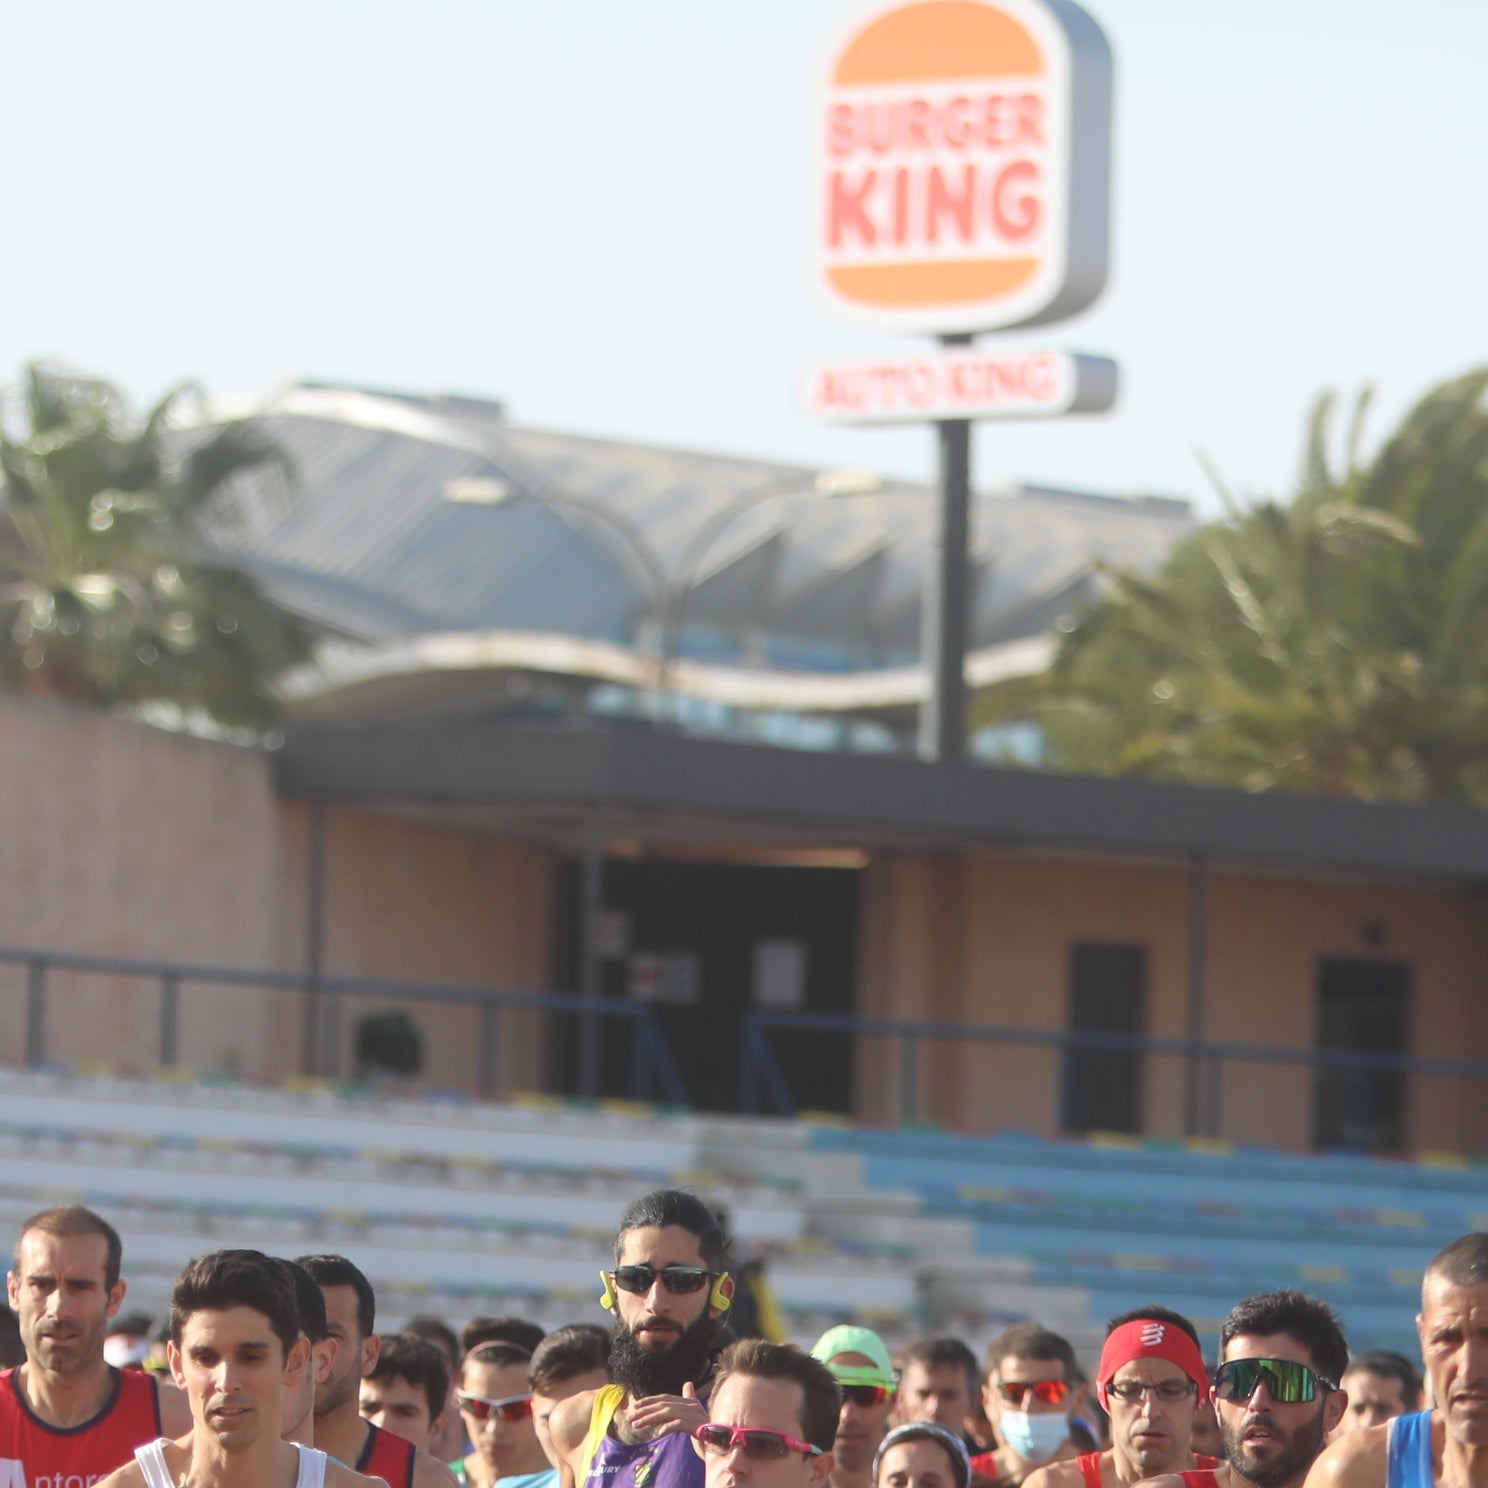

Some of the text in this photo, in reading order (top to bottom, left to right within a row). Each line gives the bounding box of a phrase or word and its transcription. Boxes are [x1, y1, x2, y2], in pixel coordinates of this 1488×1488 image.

[828, 93, 1046, 158] BURGER
[827, 159, 1042, 249] KING
[946, 354, 1058, 403] KING
